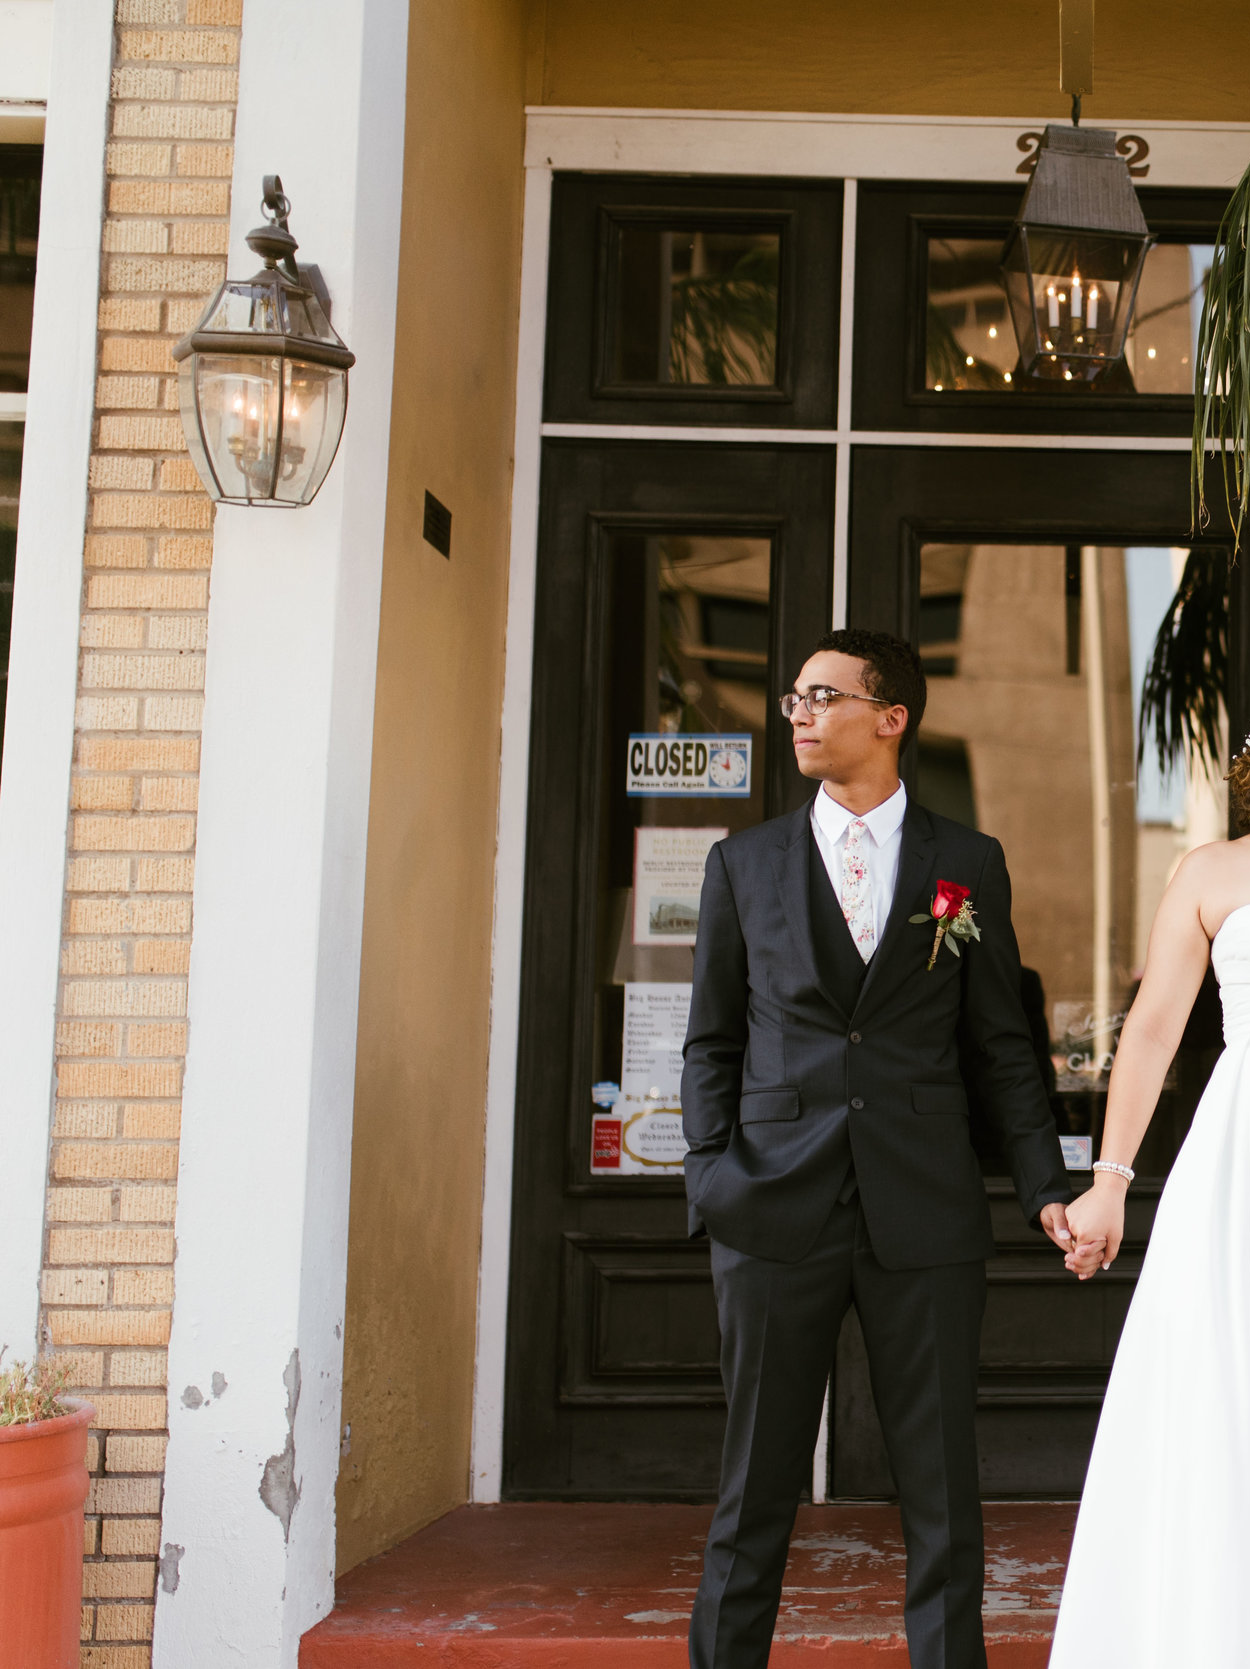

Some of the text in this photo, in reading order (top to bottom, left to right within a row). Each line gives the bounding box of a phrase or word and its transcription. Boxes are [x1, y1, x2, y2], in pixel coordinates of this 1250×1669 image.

[709, 742, 747, 751] WILL RETURN
[630, 741, 708, 777] CLOSED
[681, 781, 705, 789] Again
[672, 838, 707, 846] PUBLIC
[1067, 1052, 1115, 1072] CLO
